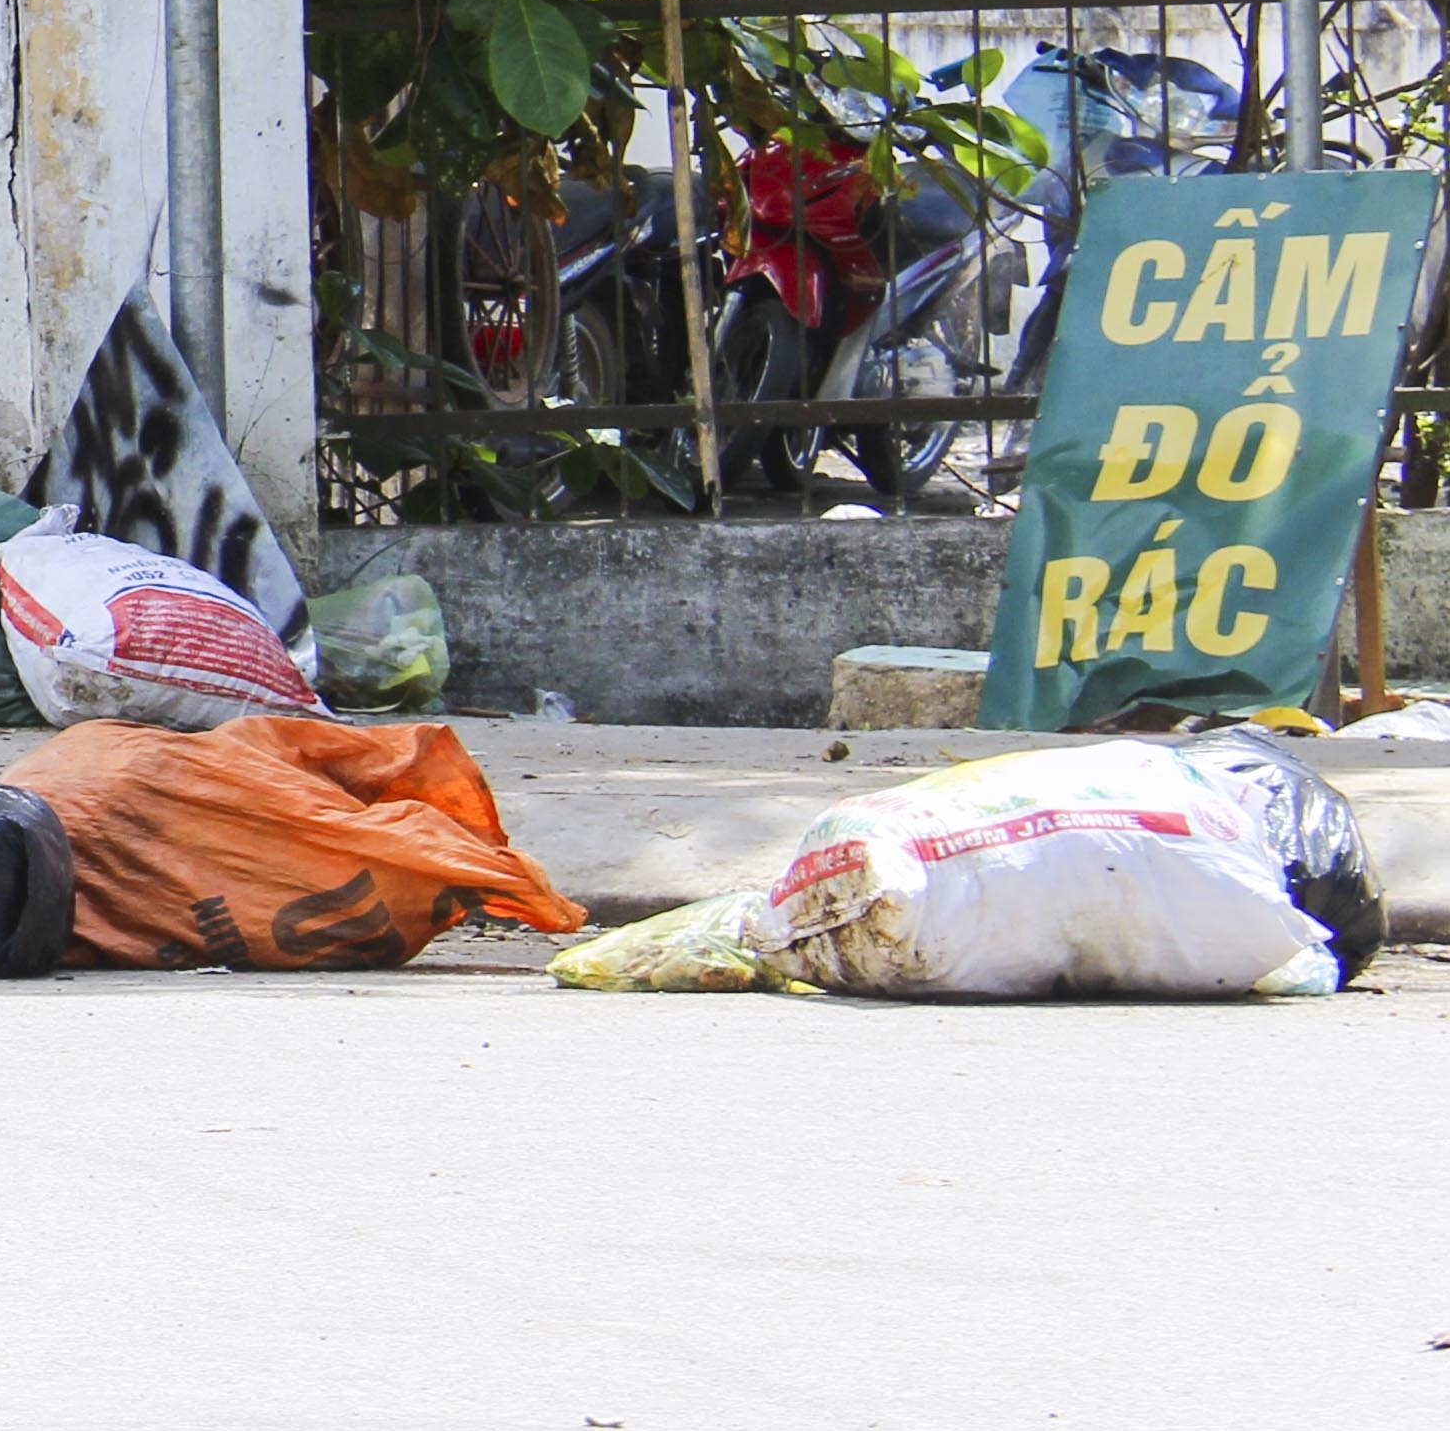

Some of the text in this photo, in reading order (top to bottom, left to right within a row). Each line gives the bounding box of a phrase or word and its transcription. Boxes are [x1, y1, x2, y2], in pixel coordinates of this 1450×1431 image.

[1100, 201, 1390, 346] CẤM
[1090, 343, 1303, 503] ĐỔ
[1034, 519, 1277, 670] RÁC
[1018, 812, 1141, 839] JASMINE
